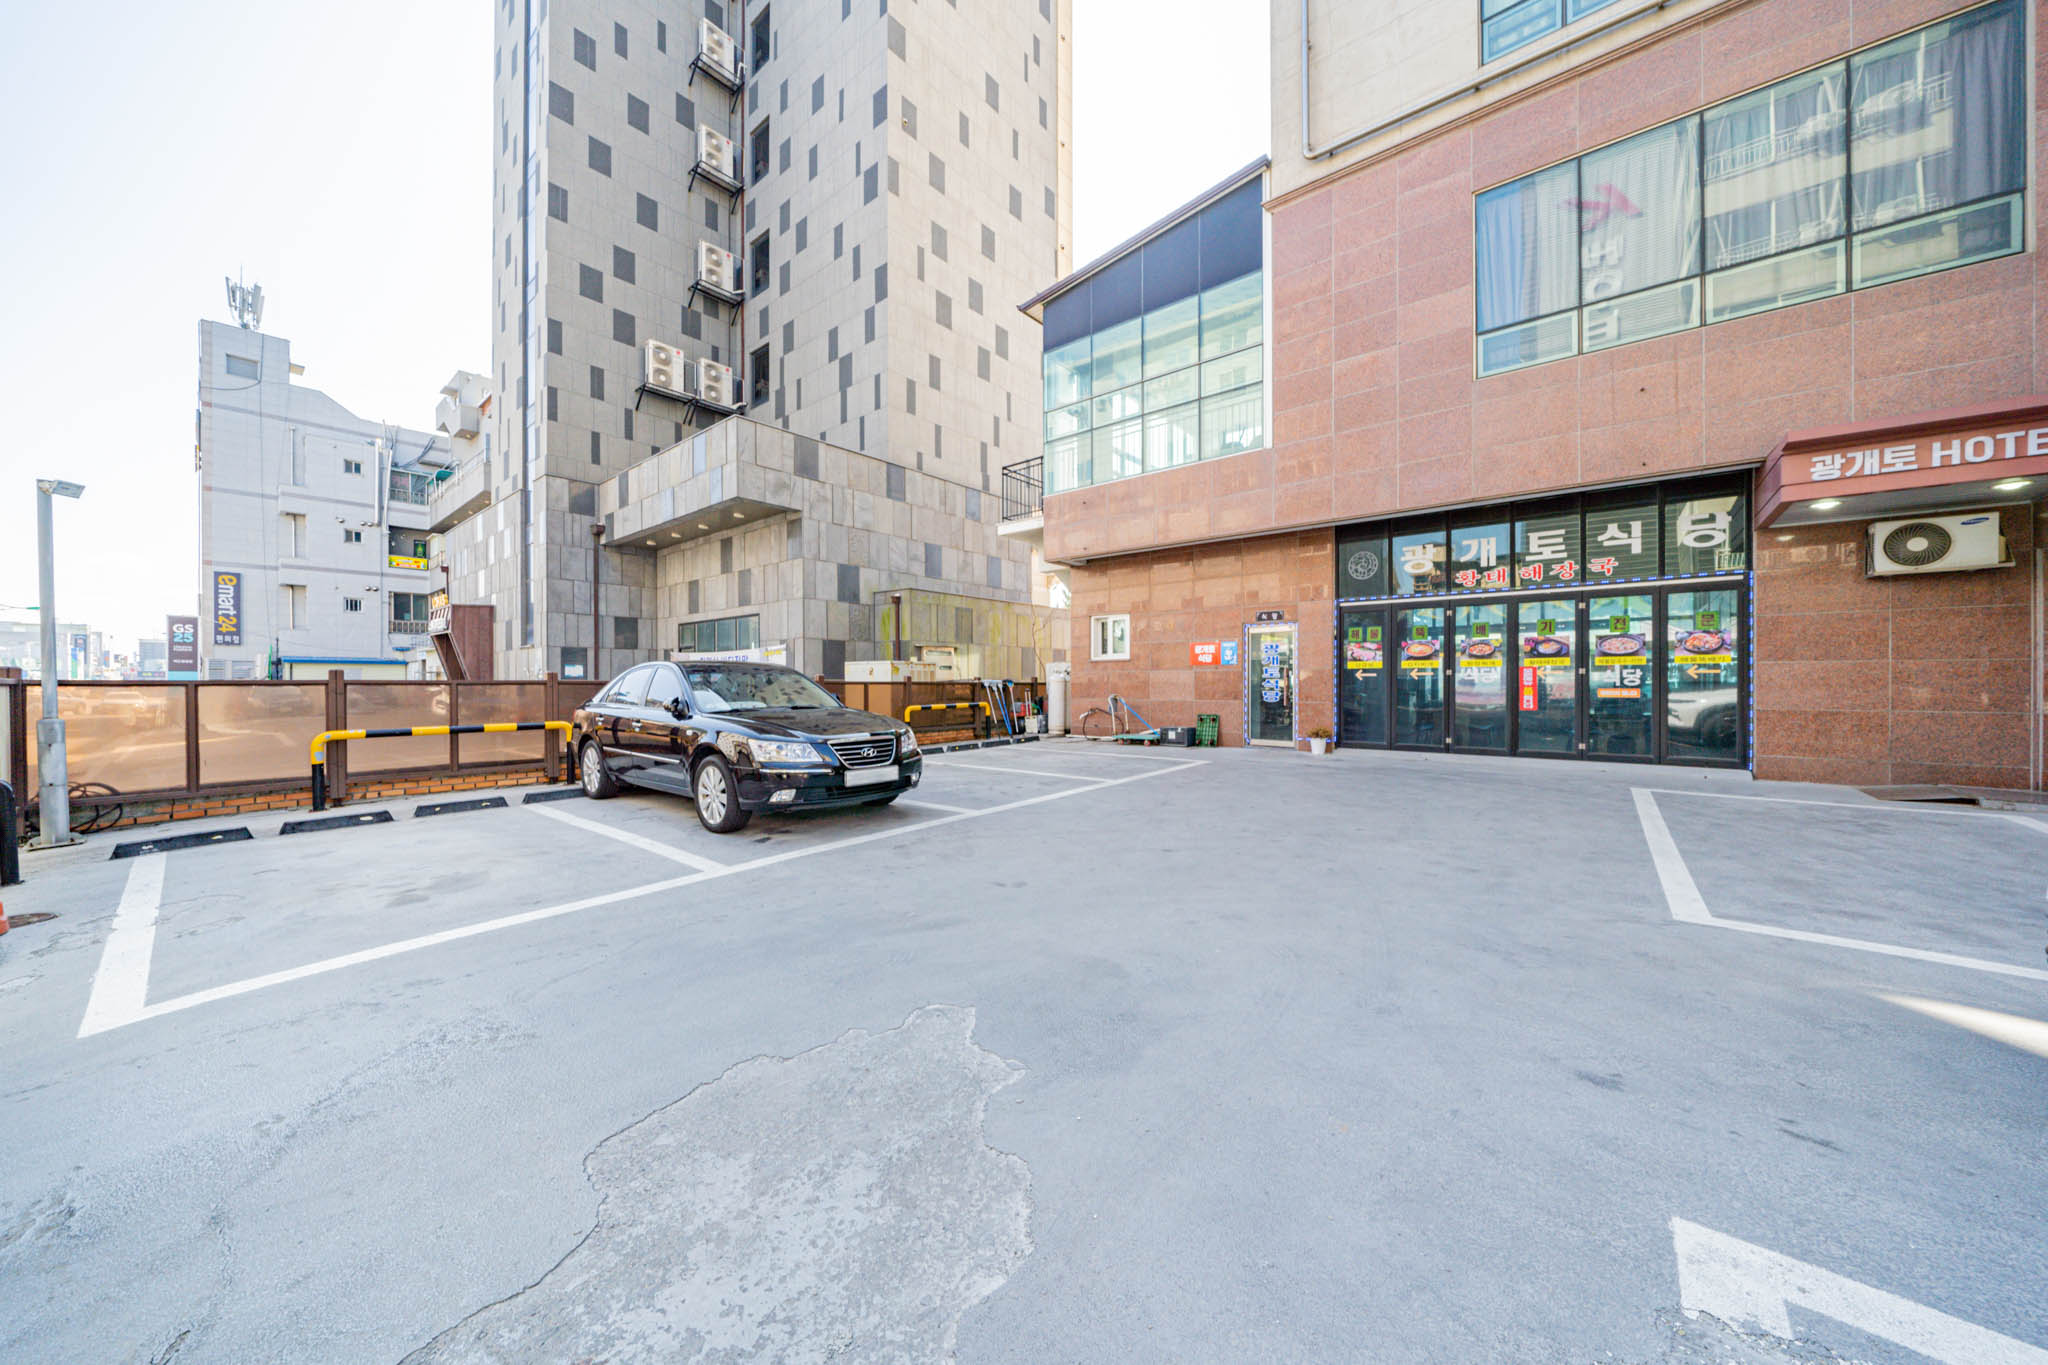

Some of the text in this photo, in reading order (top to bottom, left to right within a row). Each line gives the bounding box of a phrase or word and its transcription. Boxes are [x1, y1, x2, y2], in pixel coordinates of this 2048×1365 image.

[1810, 427, 2048, 481] 광개토 HOTE
[1400, 512, 1732, 574] 광개토식당
[1455, 556, 1619, 587] 황태해장국
[173, 624, 194, 633] GS
[173, 632, 194, 642] 25
